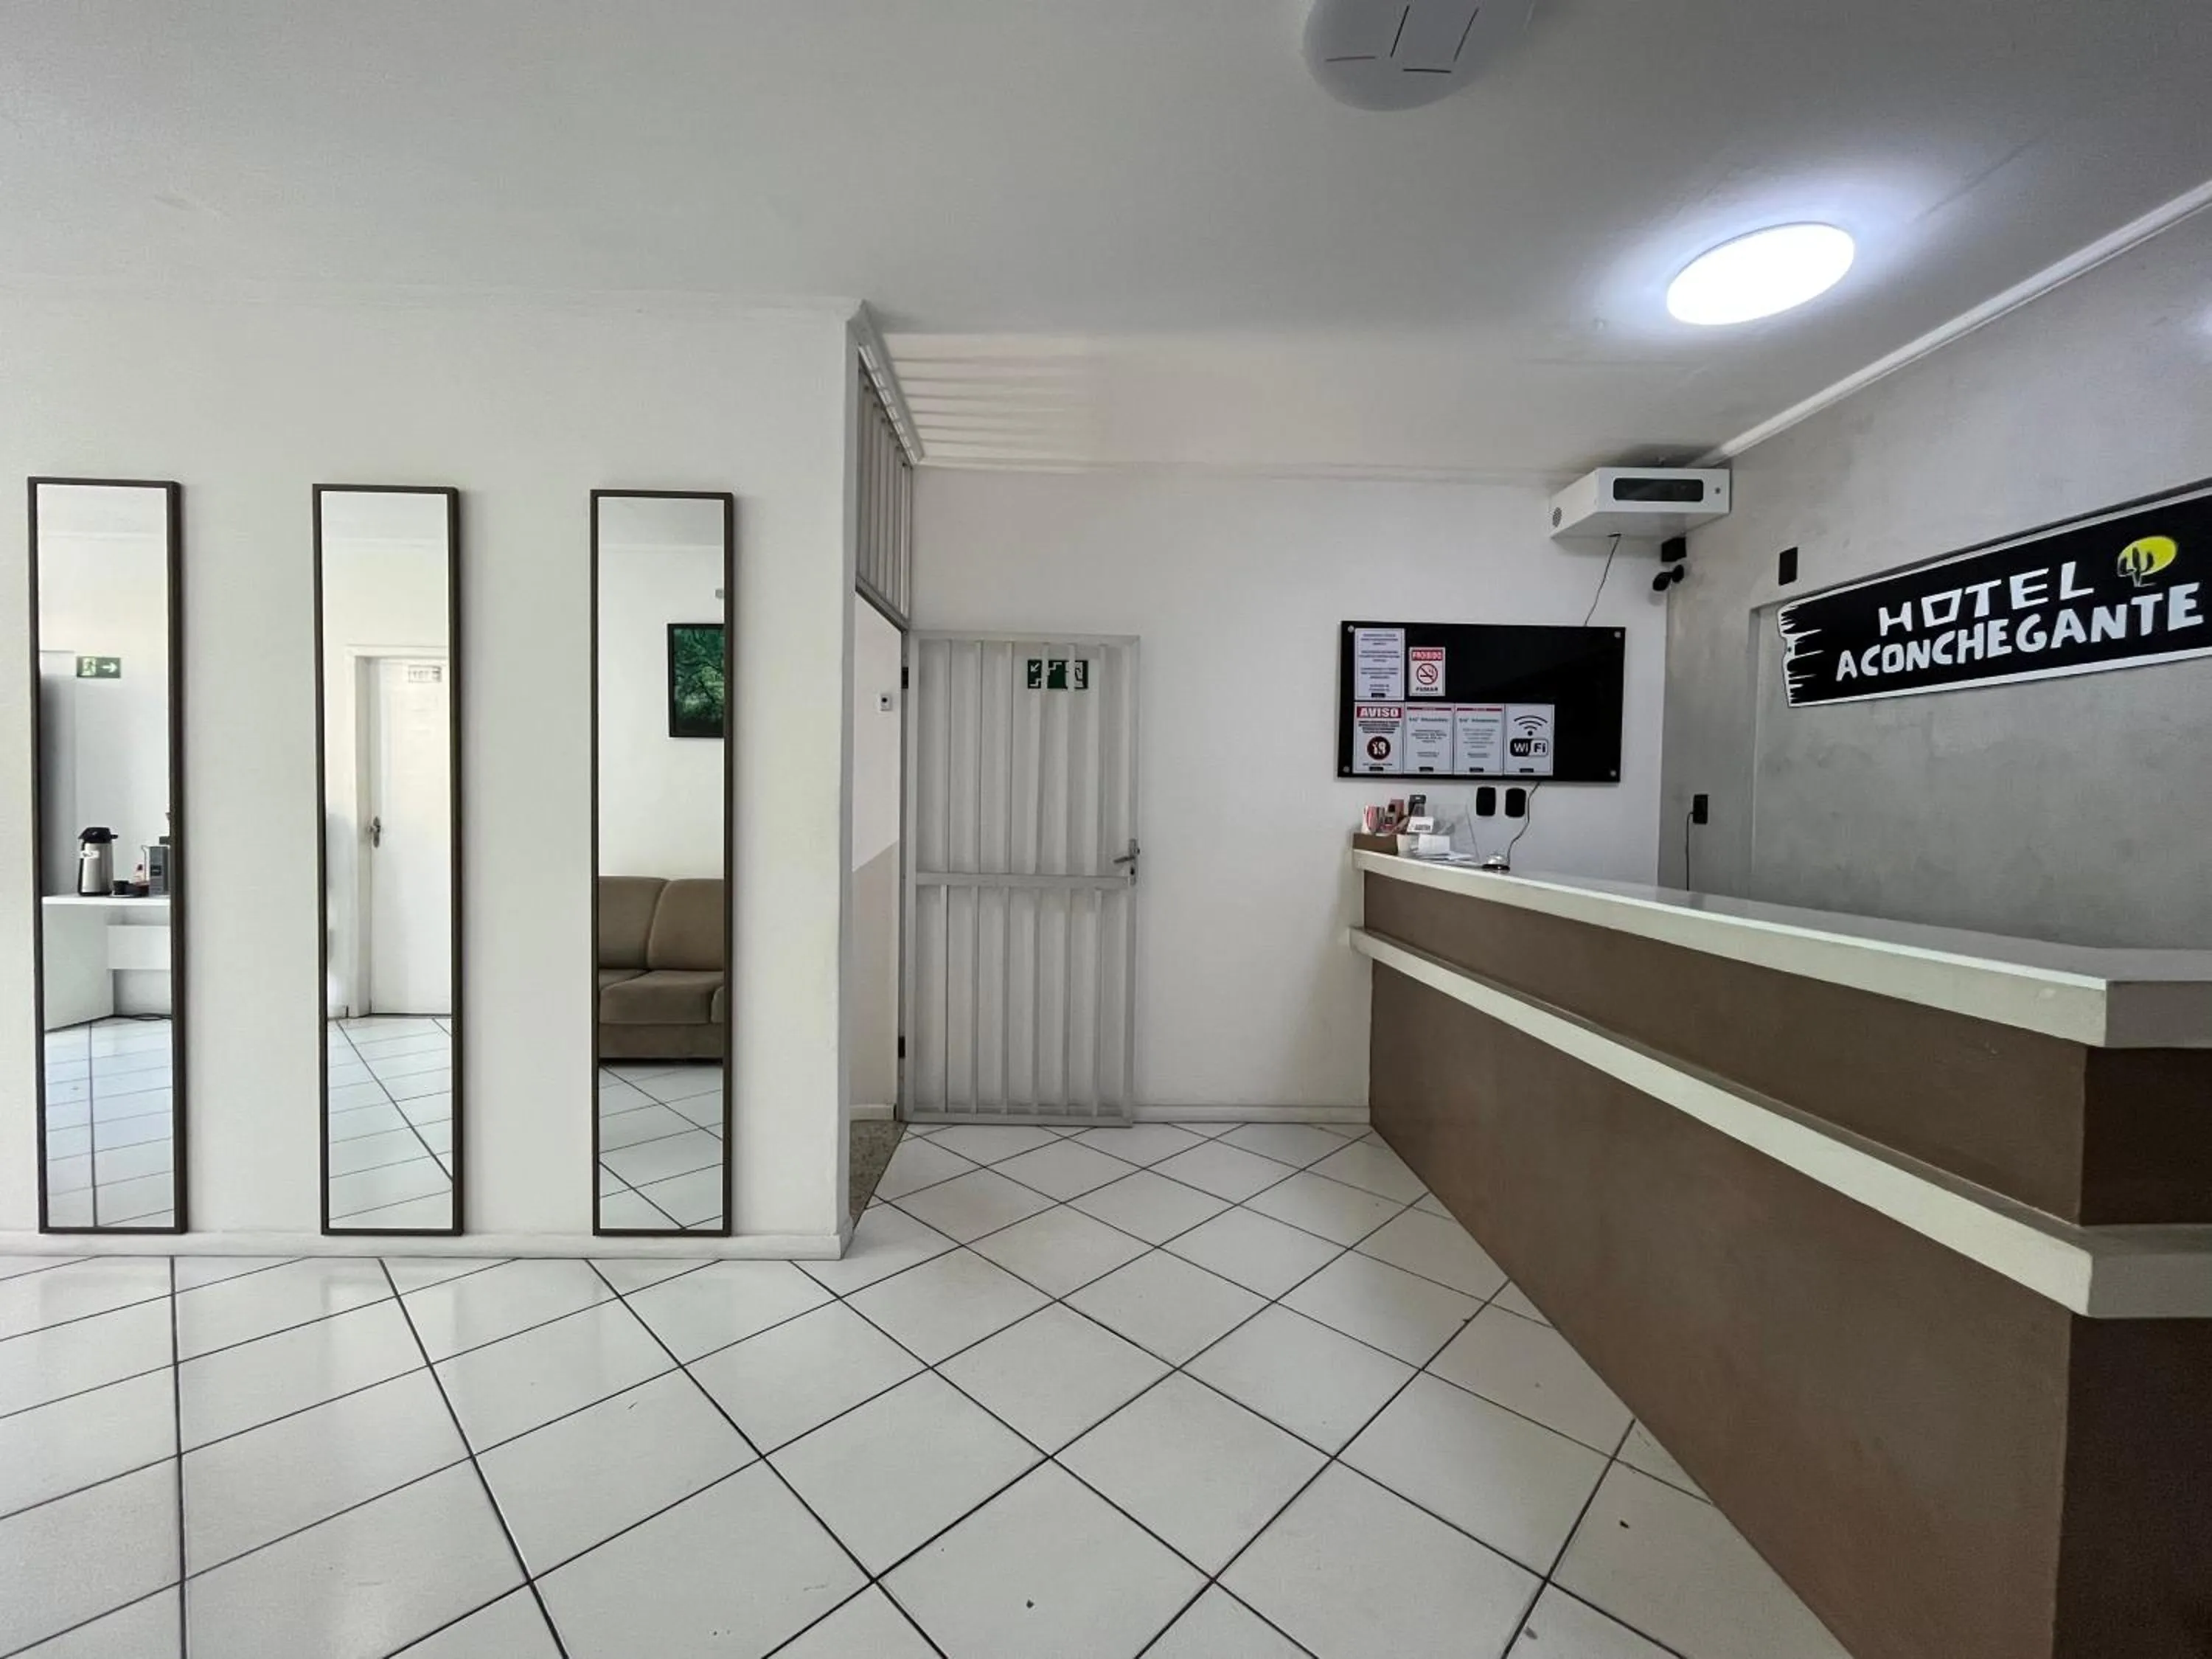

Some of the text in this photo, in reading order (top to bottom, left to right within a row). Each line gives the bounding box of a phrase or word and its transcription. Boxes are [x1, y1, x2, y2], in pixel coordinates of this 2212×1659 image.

[1836, 582, 2203, 681] ACONCHEGANTE
[1879, 561, 2093, 636] HOTEL
[1360, 707, 1399, 717] AVISO
